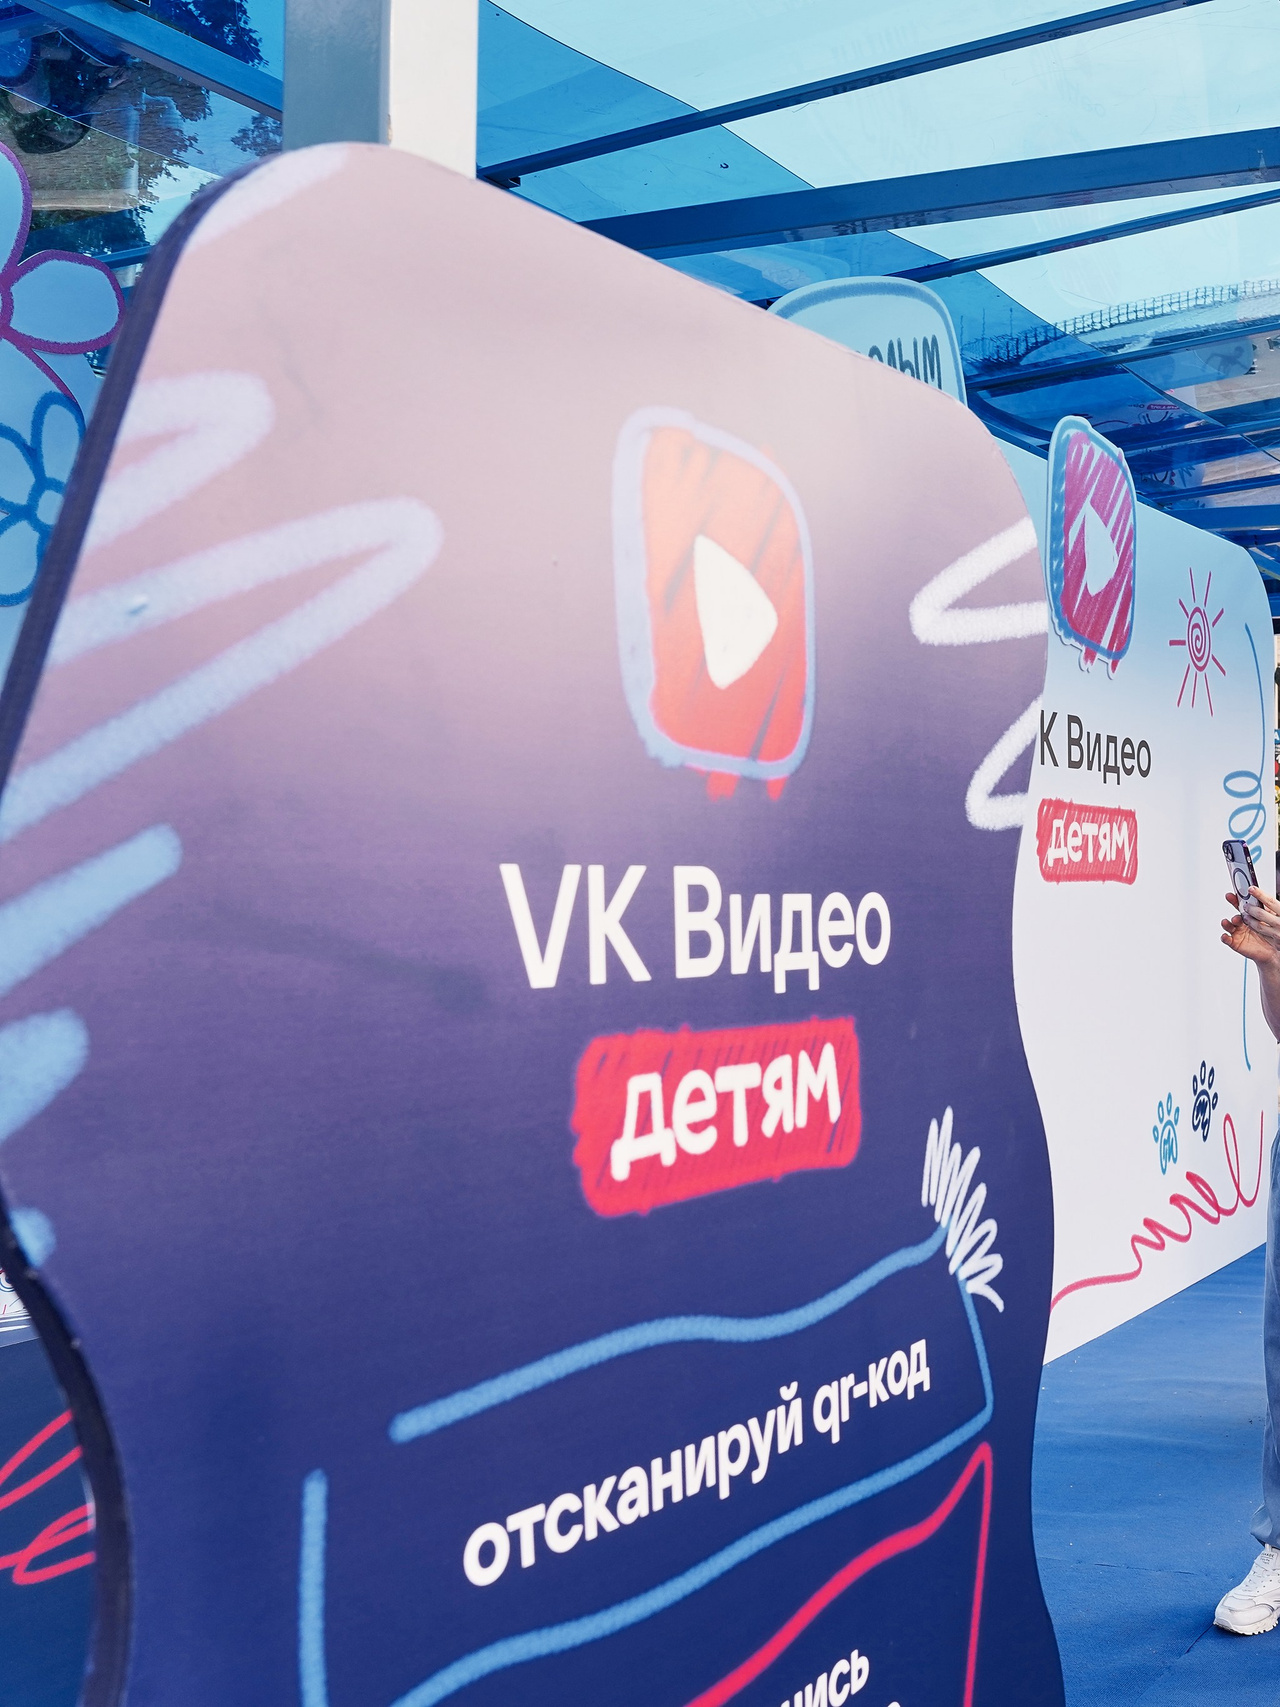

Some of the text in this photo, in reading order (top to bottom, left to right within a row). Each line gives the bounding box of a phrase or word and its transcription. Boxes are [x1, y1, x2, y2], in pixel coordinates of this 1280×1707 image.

[1040, 709, 1152, 785] K Видео
[1047, 819, 1131, 867] детям
[499, 864, 891, 994] VK Видео
[610, 1042, 841, 1181] детям
[463, 1339, 930, 1587] отсканируй qr-код
